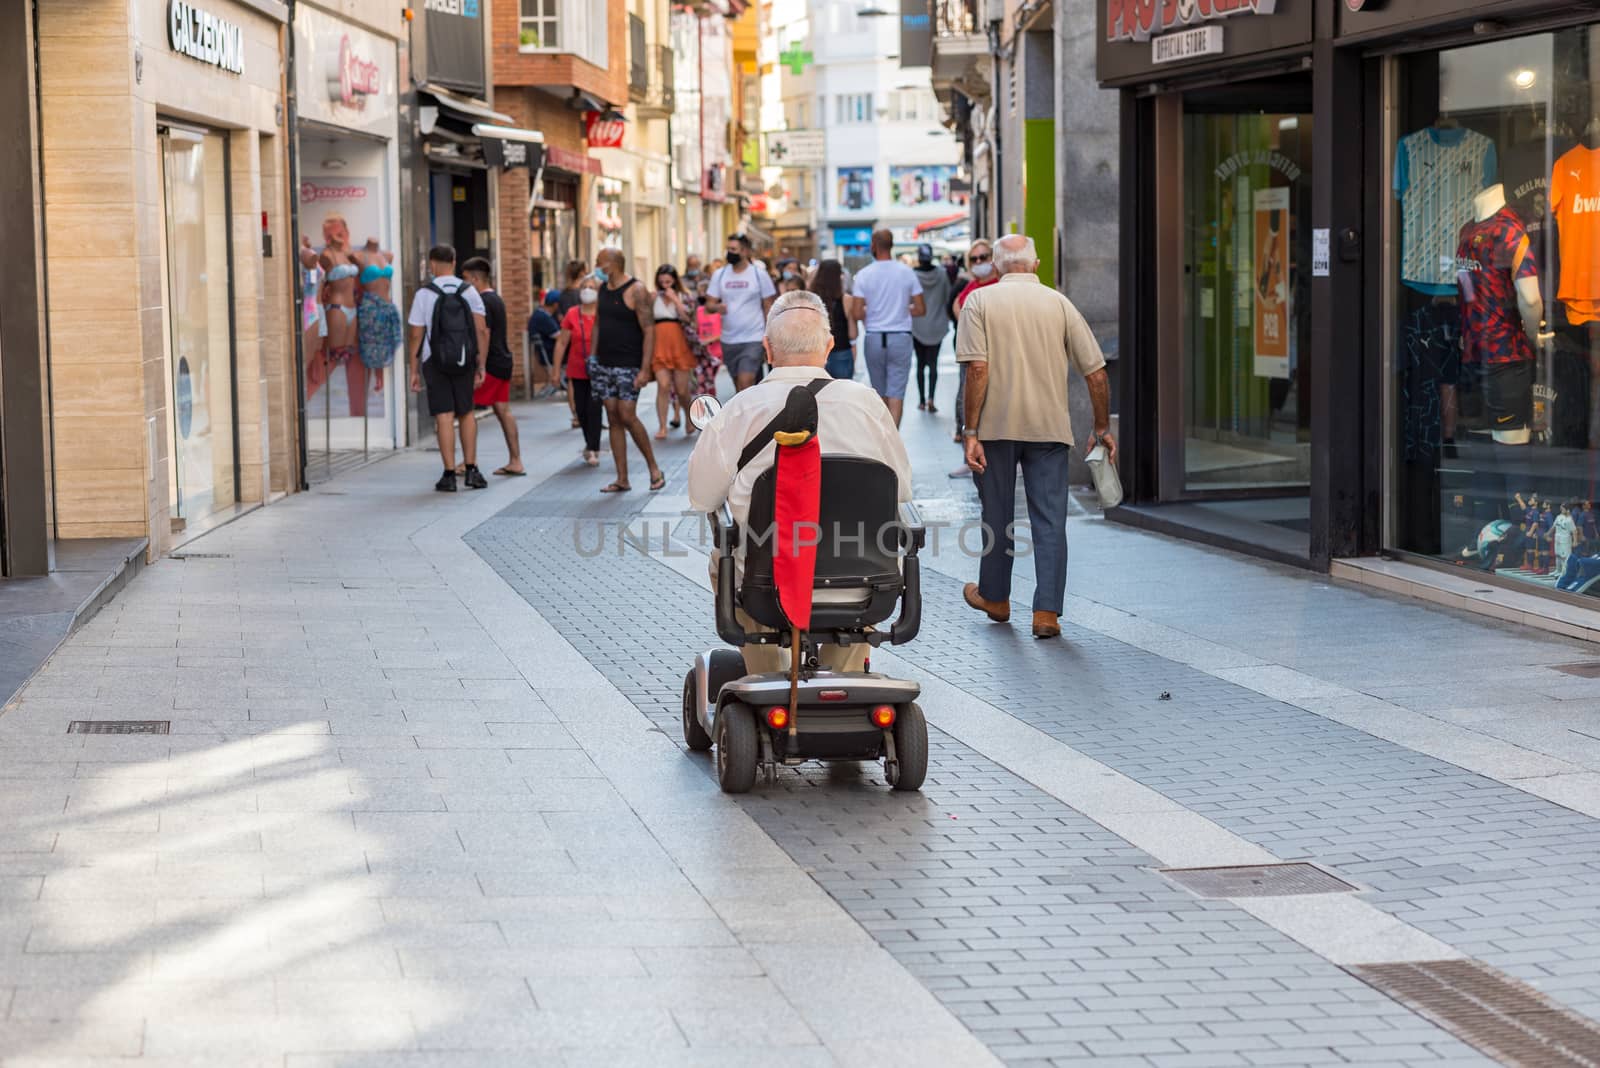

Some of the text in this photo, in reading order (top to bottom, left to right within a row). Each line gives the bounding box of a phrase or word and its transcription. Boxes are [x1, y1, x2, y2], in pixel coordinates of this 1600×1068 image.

[168, 0, 244, 74] CALZEDONIA
[1157, 29, 1206, 60] OFFICIAL STORE
[589, 115, 623, 146] illy
